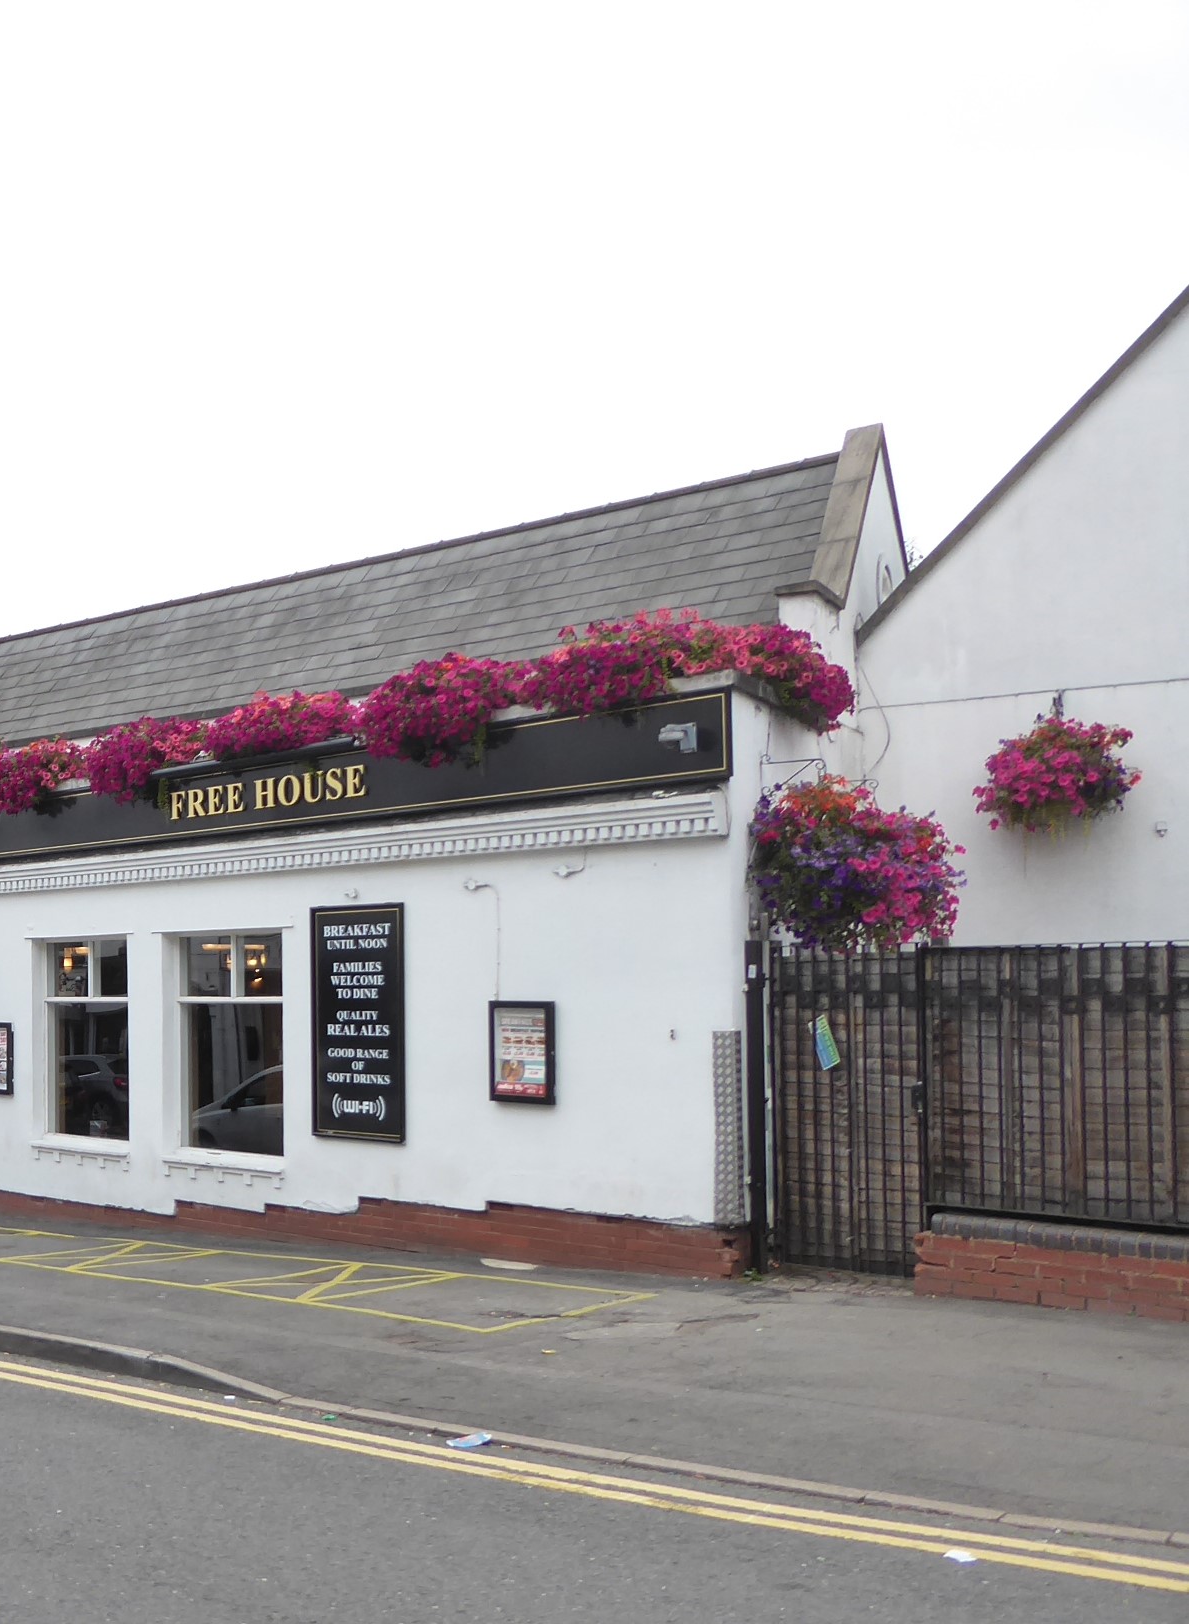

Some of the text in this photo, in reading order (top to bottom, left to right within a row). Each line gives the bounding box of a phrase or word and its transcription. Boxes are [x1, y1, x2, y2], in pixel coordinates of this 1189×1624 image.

[170, 764, 366, 820] FREE HOUSE
[323, 923, 391, 937] BREAKFAST
[327, 938, 388, 950] UNTIL NOON
[332, 961, 382, 973] FAMILIES
[330, 974, 385, 986] WELCOME
[336, 988, 379, 999] TO DINE
[336, 1010, 379, 1022] QUALITY
[327, 1023, 391, 1037] REAL ALES
[327, 1047, 389, 1059] GOOD RANGE
[351, 1060, 365, 1070] OF
[327, 1072, 391, 1085] SOFT DRINKS
[343, 1099, 374, 1114] WI-FI
